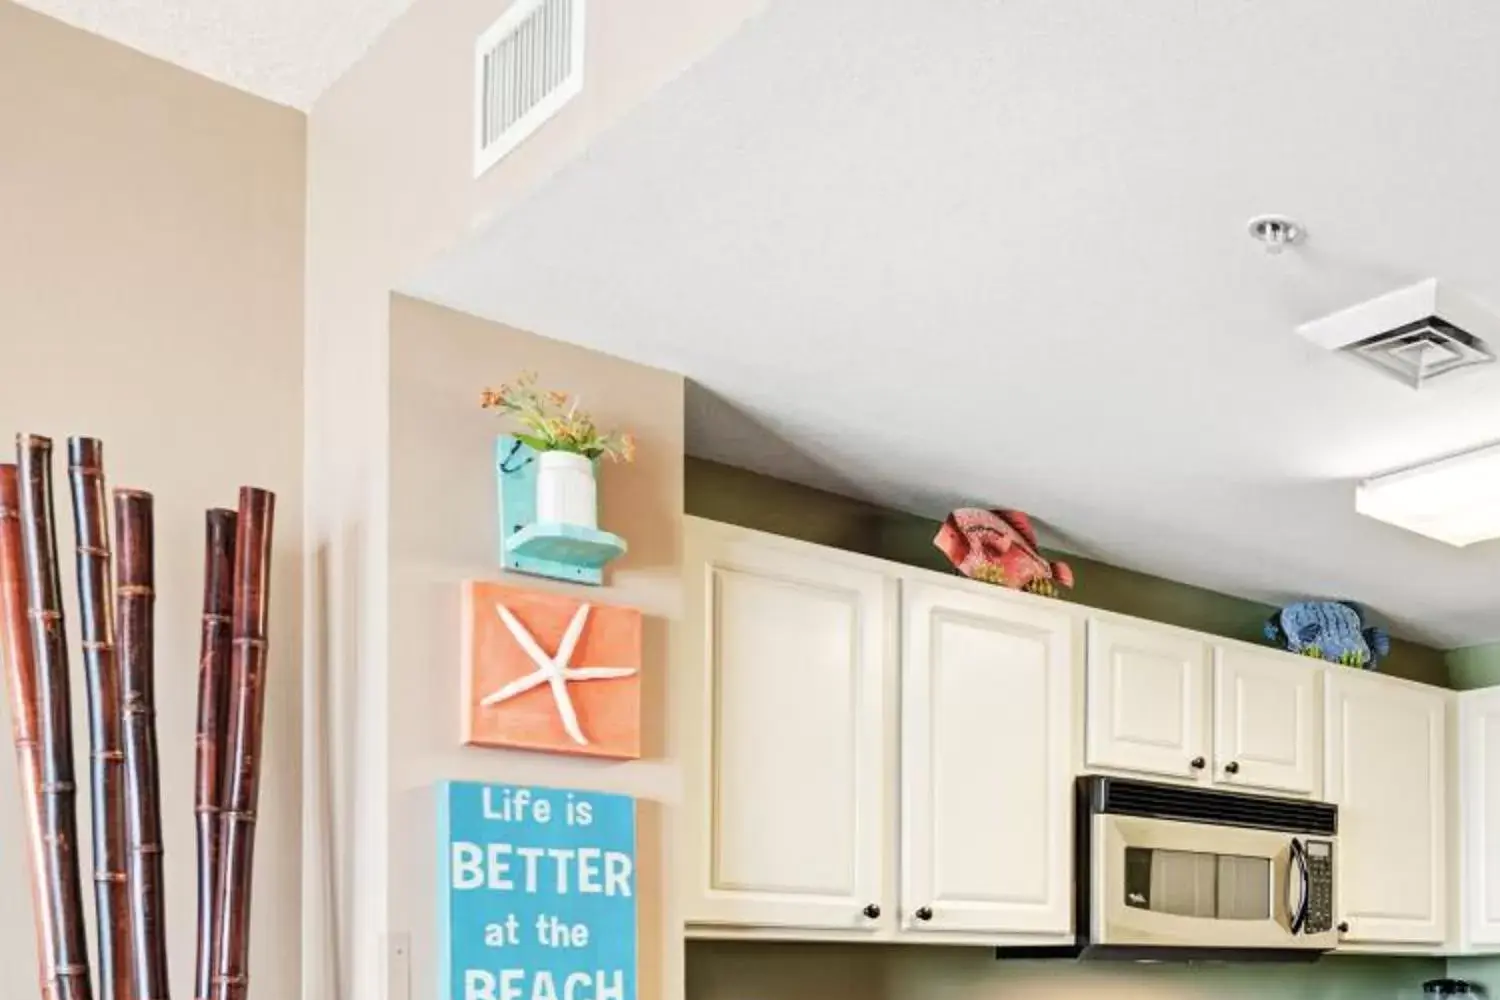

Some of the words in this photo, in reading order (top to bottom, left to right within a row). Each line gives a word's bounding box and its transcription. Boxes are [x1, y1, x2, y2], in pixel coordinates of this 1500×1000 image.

[482, 786, 552, 824] Life
[566, 792, 593, 826] is
[452, 841, 633, 897] BETTER
[484, 914, 520, 947] at
[535, 913, 589, 948] the
